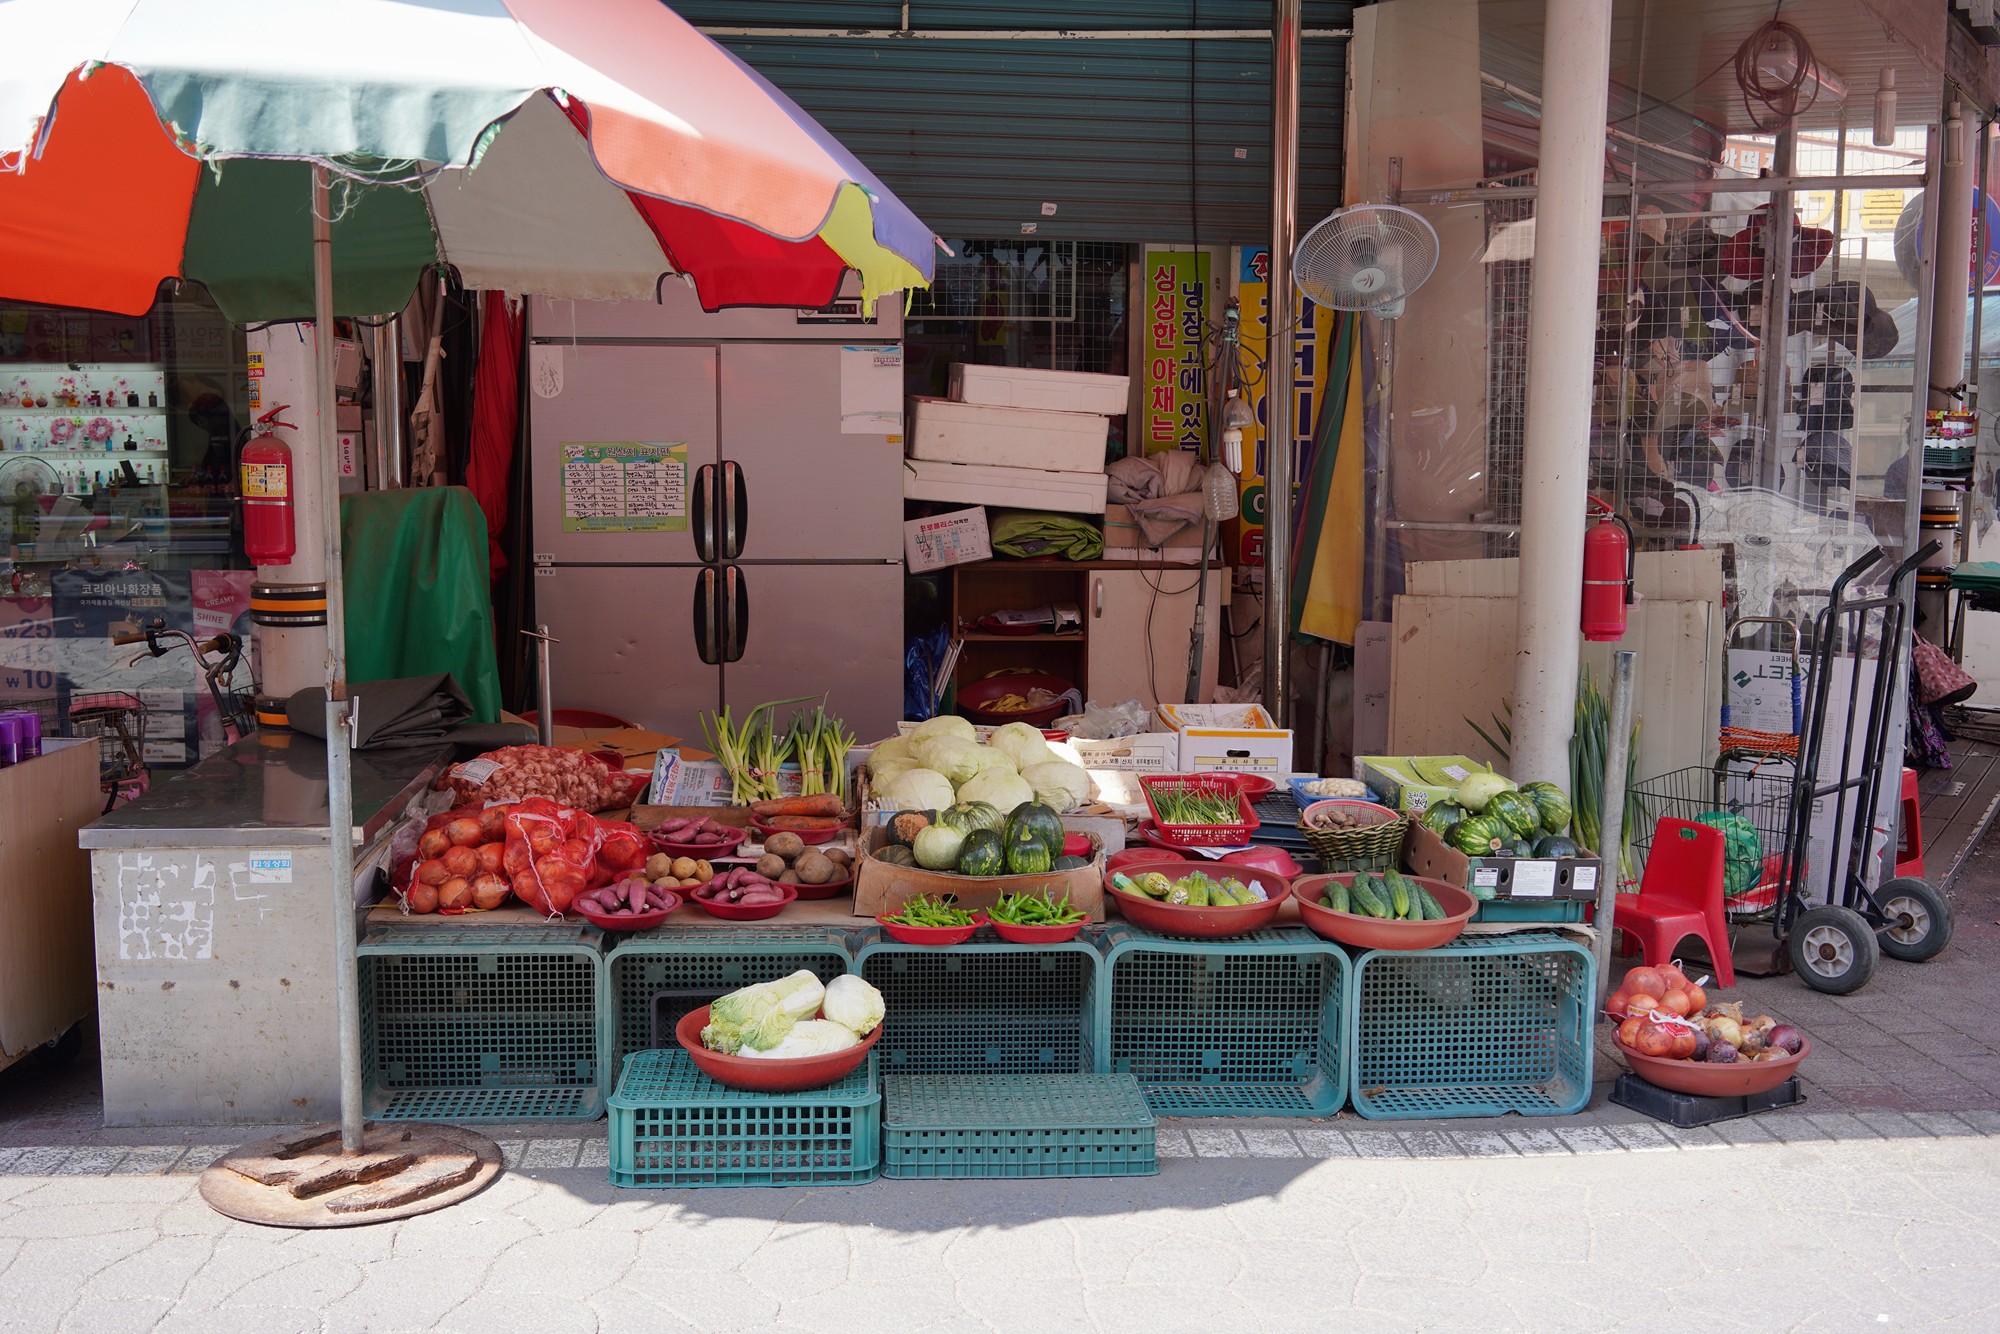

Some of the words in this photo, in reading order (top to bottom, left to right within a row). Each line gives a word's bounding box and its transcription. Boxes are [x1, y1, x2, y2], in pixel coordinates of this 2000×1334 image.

[1796, 189, 1904, 231] 기름
[1152, 264, 1177, 350] 싱싱한
[1179, 282, 1203, 394] 냉장고에
[1151, 357, 1177, 442] 야채는
[606, 446, 637, 457] 원산지
[640, 446, 671, 457] 표시판
[81, 583, 162, 596] 코리아나화장품
[204, 595, 235, 607] CREAMY
[196, 612, 224, 624] SHINE
